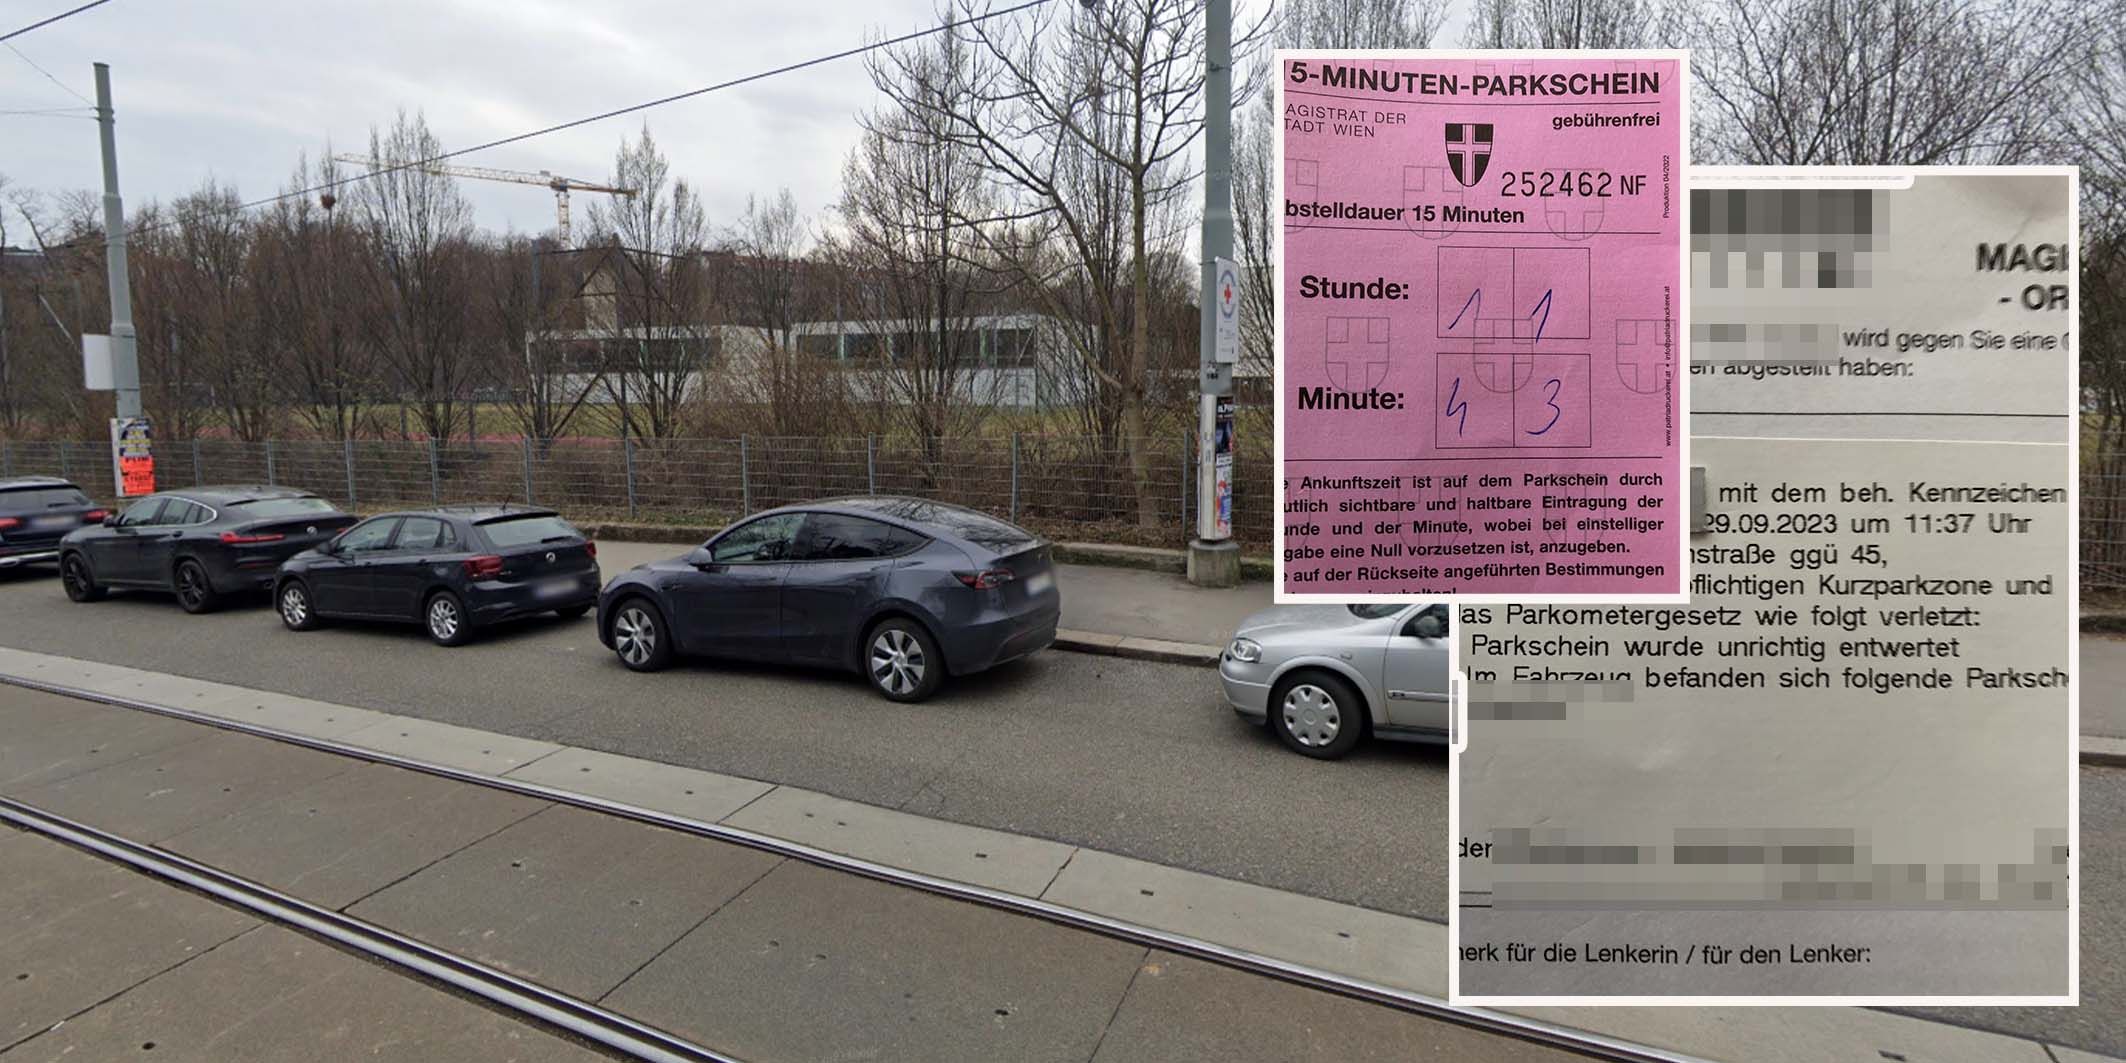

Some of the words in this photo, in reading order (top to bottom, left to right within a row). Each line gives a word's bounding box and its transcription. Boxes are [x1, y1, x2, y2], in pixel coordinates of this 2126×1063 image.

[1375, 112, 1406, 125] DER
[1553, 112, 1659, 130] gebührenfrei
[1334, 124, 1375, 137] WIEN
[1502, 172, 1611, 197] 252462
[1621, 175, 1646, 195] NF
[1284, 200, 1405, 221] bstelldauer
[1413, 206, 1435, 222] 15
[1443, 207, 1524, 223] Minuten
[1300, 275, 1408, 300] Stunde:
[1844, 329, 1888, 348] wird
[1898, 331, 1962, 352] gegen
[1970, 329, 2006, 350] Sie
[2010, 330, 2058, 350] eine
[1839, 356, 1913, 376] haben:
[1298, 386, 1404, 410] Minute:
[1526, 379, 1560, 435] 3
[1301, 476, 1400, 490] Ankunftszeit
[1412, 476, 1431, 489] ist
[1443, 474, 1467, 488] auf
[1479, 474, 1511, 487] dem
[1524, 473, 1607, 487] Parkschein
[1620, 473, 1662, 486] durch
[1720, 482, 1758, 502] mit
[1771, 483, 1825, 503] dem
[1841, 482, 1893, 502] beh.
[1910, 482, 2065, 502] Kennzeichen
[1339, 498, 1415, 512] sichtbare
[1427, 498, 1455, 511] und
[1468, 497, 1531, 510] haltbare
[1543, 496, 1626, 511] Eintragung
[1637, 496, 1662, 509] der
[1332, 521, 1362, 535] und
[1375, 521, 1401, 534] der
[1414, 520, 1472, 536] Minute,
[1484, 519, 1531, 532] wobei
[1543, 518, 1566, 532] bei
[1577, 517, 1663, 534] einstelliger
[1705, 513, 1836, 535] 29.09.2023
[1852, 518, 1889, 533] um
[1904, 514, 1975, 533] 11:37
[1989, 513, 2032, 533] Uhr
[1330, 546, 1364, 558] eine
[1371, 544, 1401, 556] Null
[1408, 542, 1504, 556] vorzusetzen
[1511, 542, 1533, 556] ist,
[1540, 540, 1630, 556] anzugeben.
[1790, 544, 1837, 569] ggü
[1851, 545, 1887, 568] 45,
[1294, 568, 1319, 581] auf
[1325, 567, 1352, 581] der
[1358, 564, 1438, 579] Rückseite
[1444, 563, 1539, 581] angeführten
[1546, 562, 1664, 579] Bestimmungen
[1691, 574, 1804, 598] flichtigen
[1820, 574, 1992, 600] Kurzparkzone
[2006, 575, 2052, 595] und
[1508, 604, 1742, 631] Parkometergesetz
[1755, 605, 1797, 625] wie
[1811, 605, 1867, 631] folgt
[1880, 606, 1980, 626] verletzt:
[1472, 634, 1608, 656] Parkschein
[1624, 636, 1703, 656] wurde
[1718, 636, 1825, 662] unrichtig
[1840, 638, 1960, 657] entwertet
[1646, 667, 1764, 688] befanden
[1779, 667, 1829, 688] sich
[1842, 667, 1952, 694] folgende
[1967, 667, 2069, 688] Parksch
[1506, 943, 1536, 961] für
[1544, 943, 1576, 962] die
[1586, 943, 1677, 964] Lenkerin
[1702, 945, 1732, 964] für
[1740, 945, 1780, 964] den
[1790, 944, 1870, 963] Lenker:
